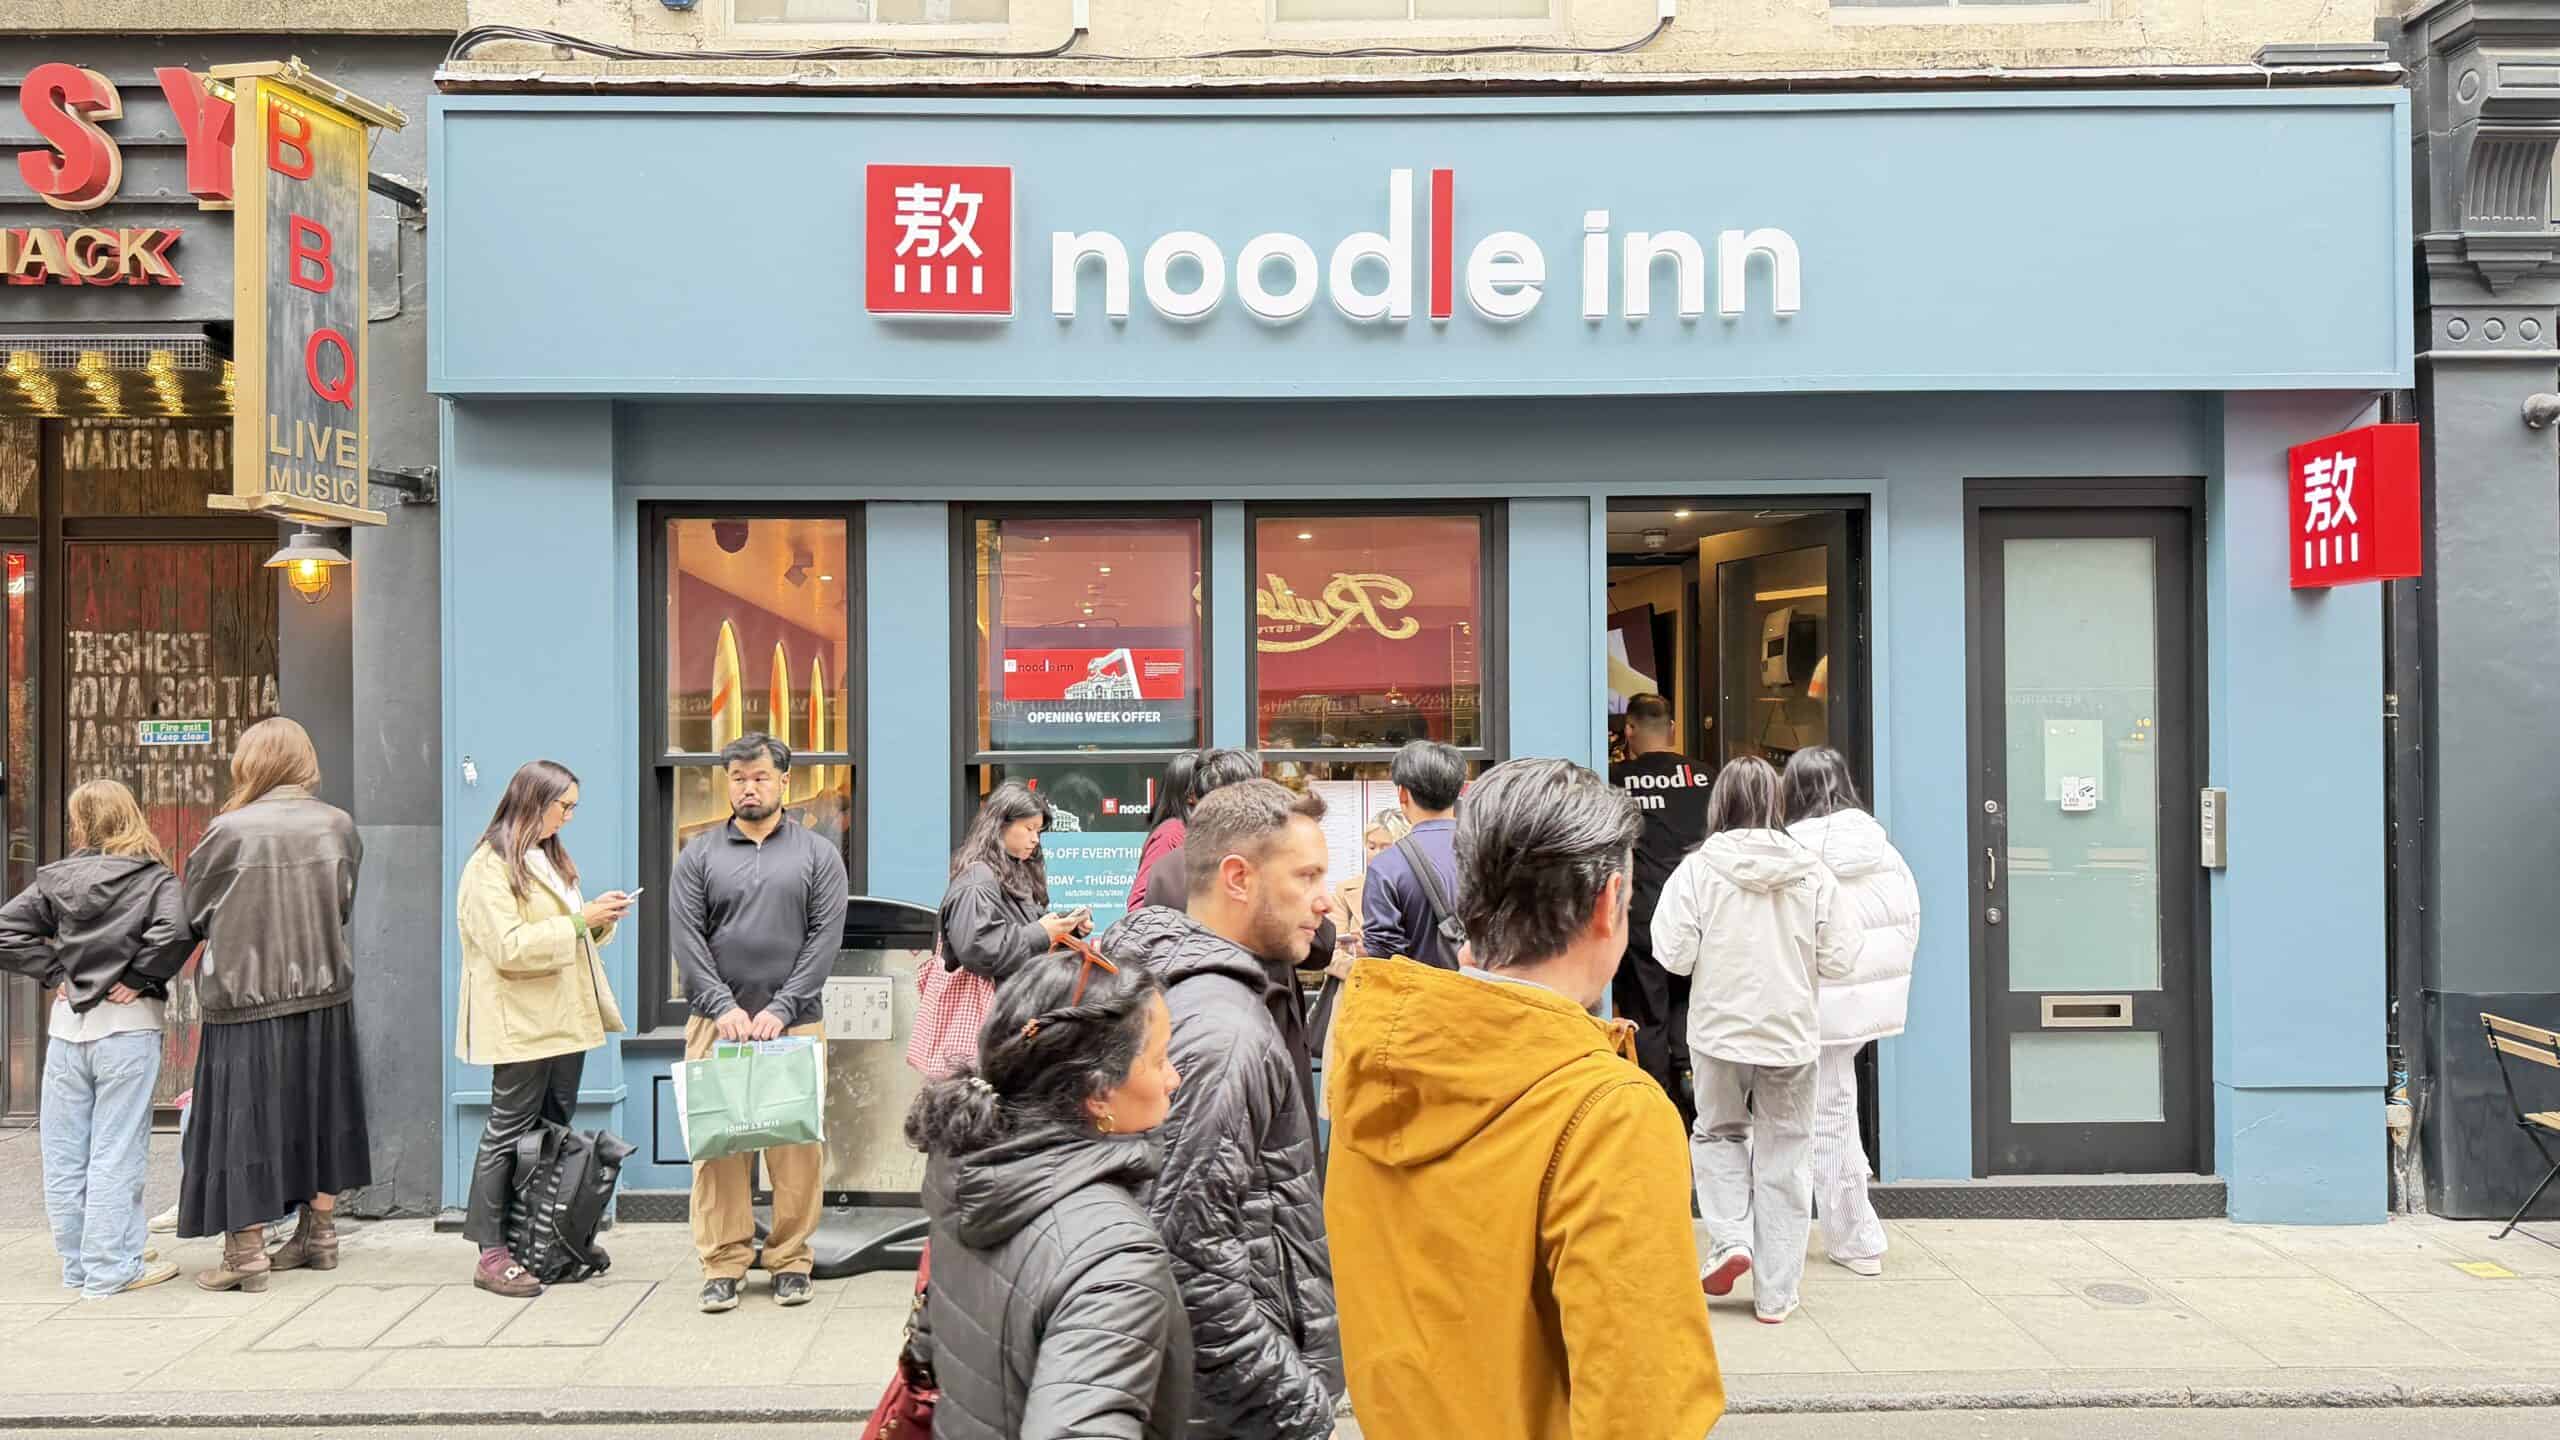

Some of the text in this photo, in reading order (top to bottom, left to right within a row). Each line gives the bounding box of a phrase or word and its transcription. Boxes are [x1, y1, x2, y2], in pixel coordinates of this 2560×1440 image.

[1051, 167, 1802, 324] noodle inn
[63, 428, 234, 471] MARGARI
[270, 414, 358, 470] LIVE
[270, 464, 358, 505] MUSIC
[69, 631, 211, 674] RESHEST
[157, 674, 280, 719] SCOTIA
[159, 723, 202, 732] Fire exit
[1027, 711, 1161, 724] OPENING WEEK OFFER
[157, 731, 205, 742] Keep clear
[1624, 764, 1710, 790] noodle
[1056, 847, 1080, 859] OFF
[1046, 874, 1074, 886] RDAY
